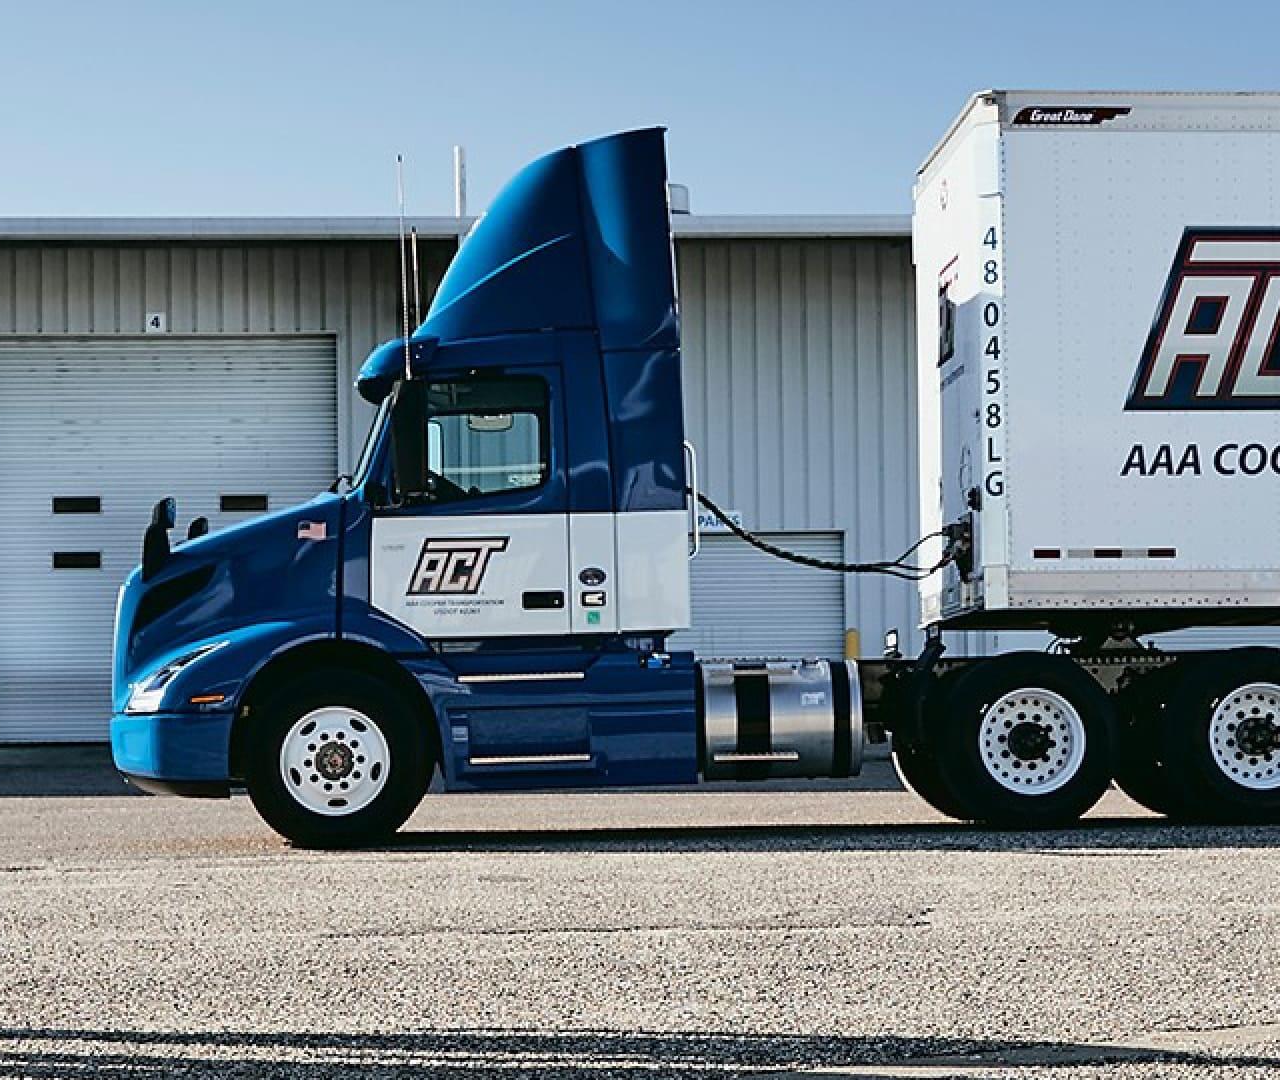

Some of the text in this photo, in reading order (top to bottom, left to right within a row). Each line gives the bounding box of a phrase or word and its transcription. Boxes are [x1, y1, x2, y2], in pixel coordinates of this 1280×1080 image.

[1029, 109, 1094, 122] Great Dane
[151, 315, 161, 329] 4
[1120, 443, 1202, 477] AAA
[698, 514, 740, 527] PARS
[408, 537, 508, 595] ACT
